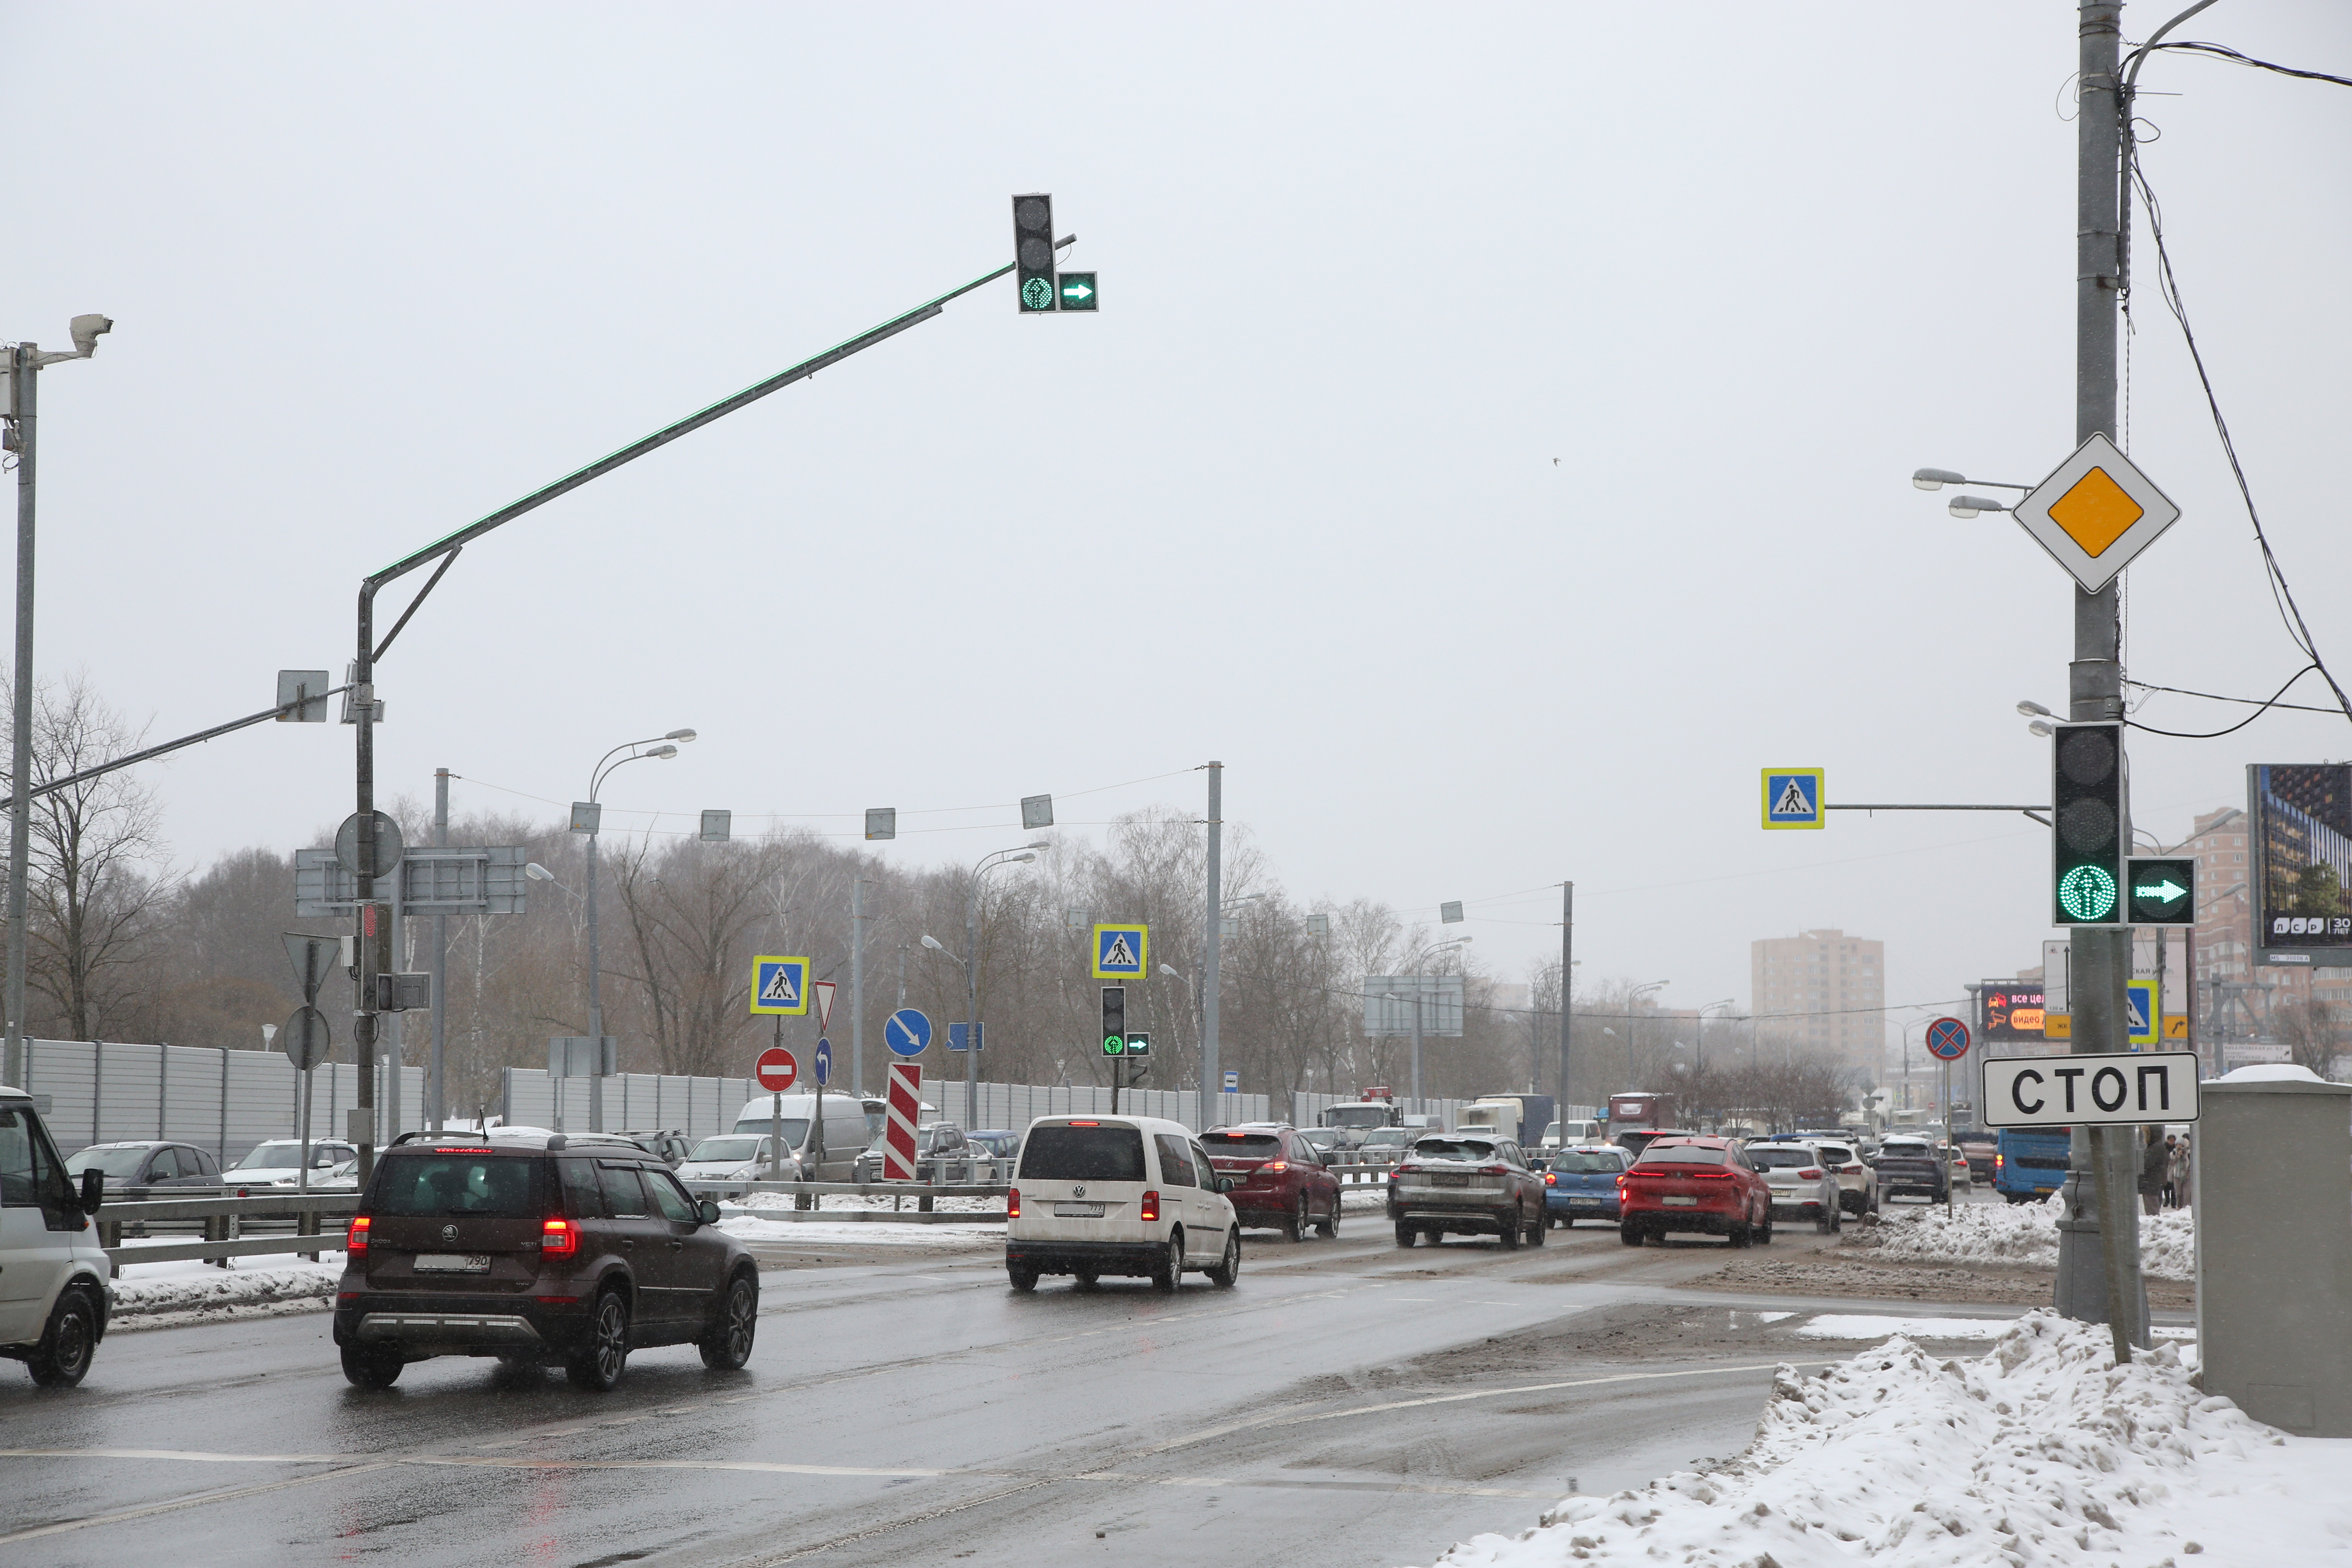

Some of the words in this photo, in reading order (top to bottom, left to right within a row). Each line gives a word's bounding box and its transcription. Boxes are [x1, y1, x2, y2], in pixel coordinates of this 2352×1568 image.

[2333, 918, 2351, 928] 30
[2011, 994, 2028, 1003] все
[2013, 1016, 2040, 1025] видео
[2012, 1065, 2169, 1115] СТОП
[469, 1256, 487, 1265] 790
